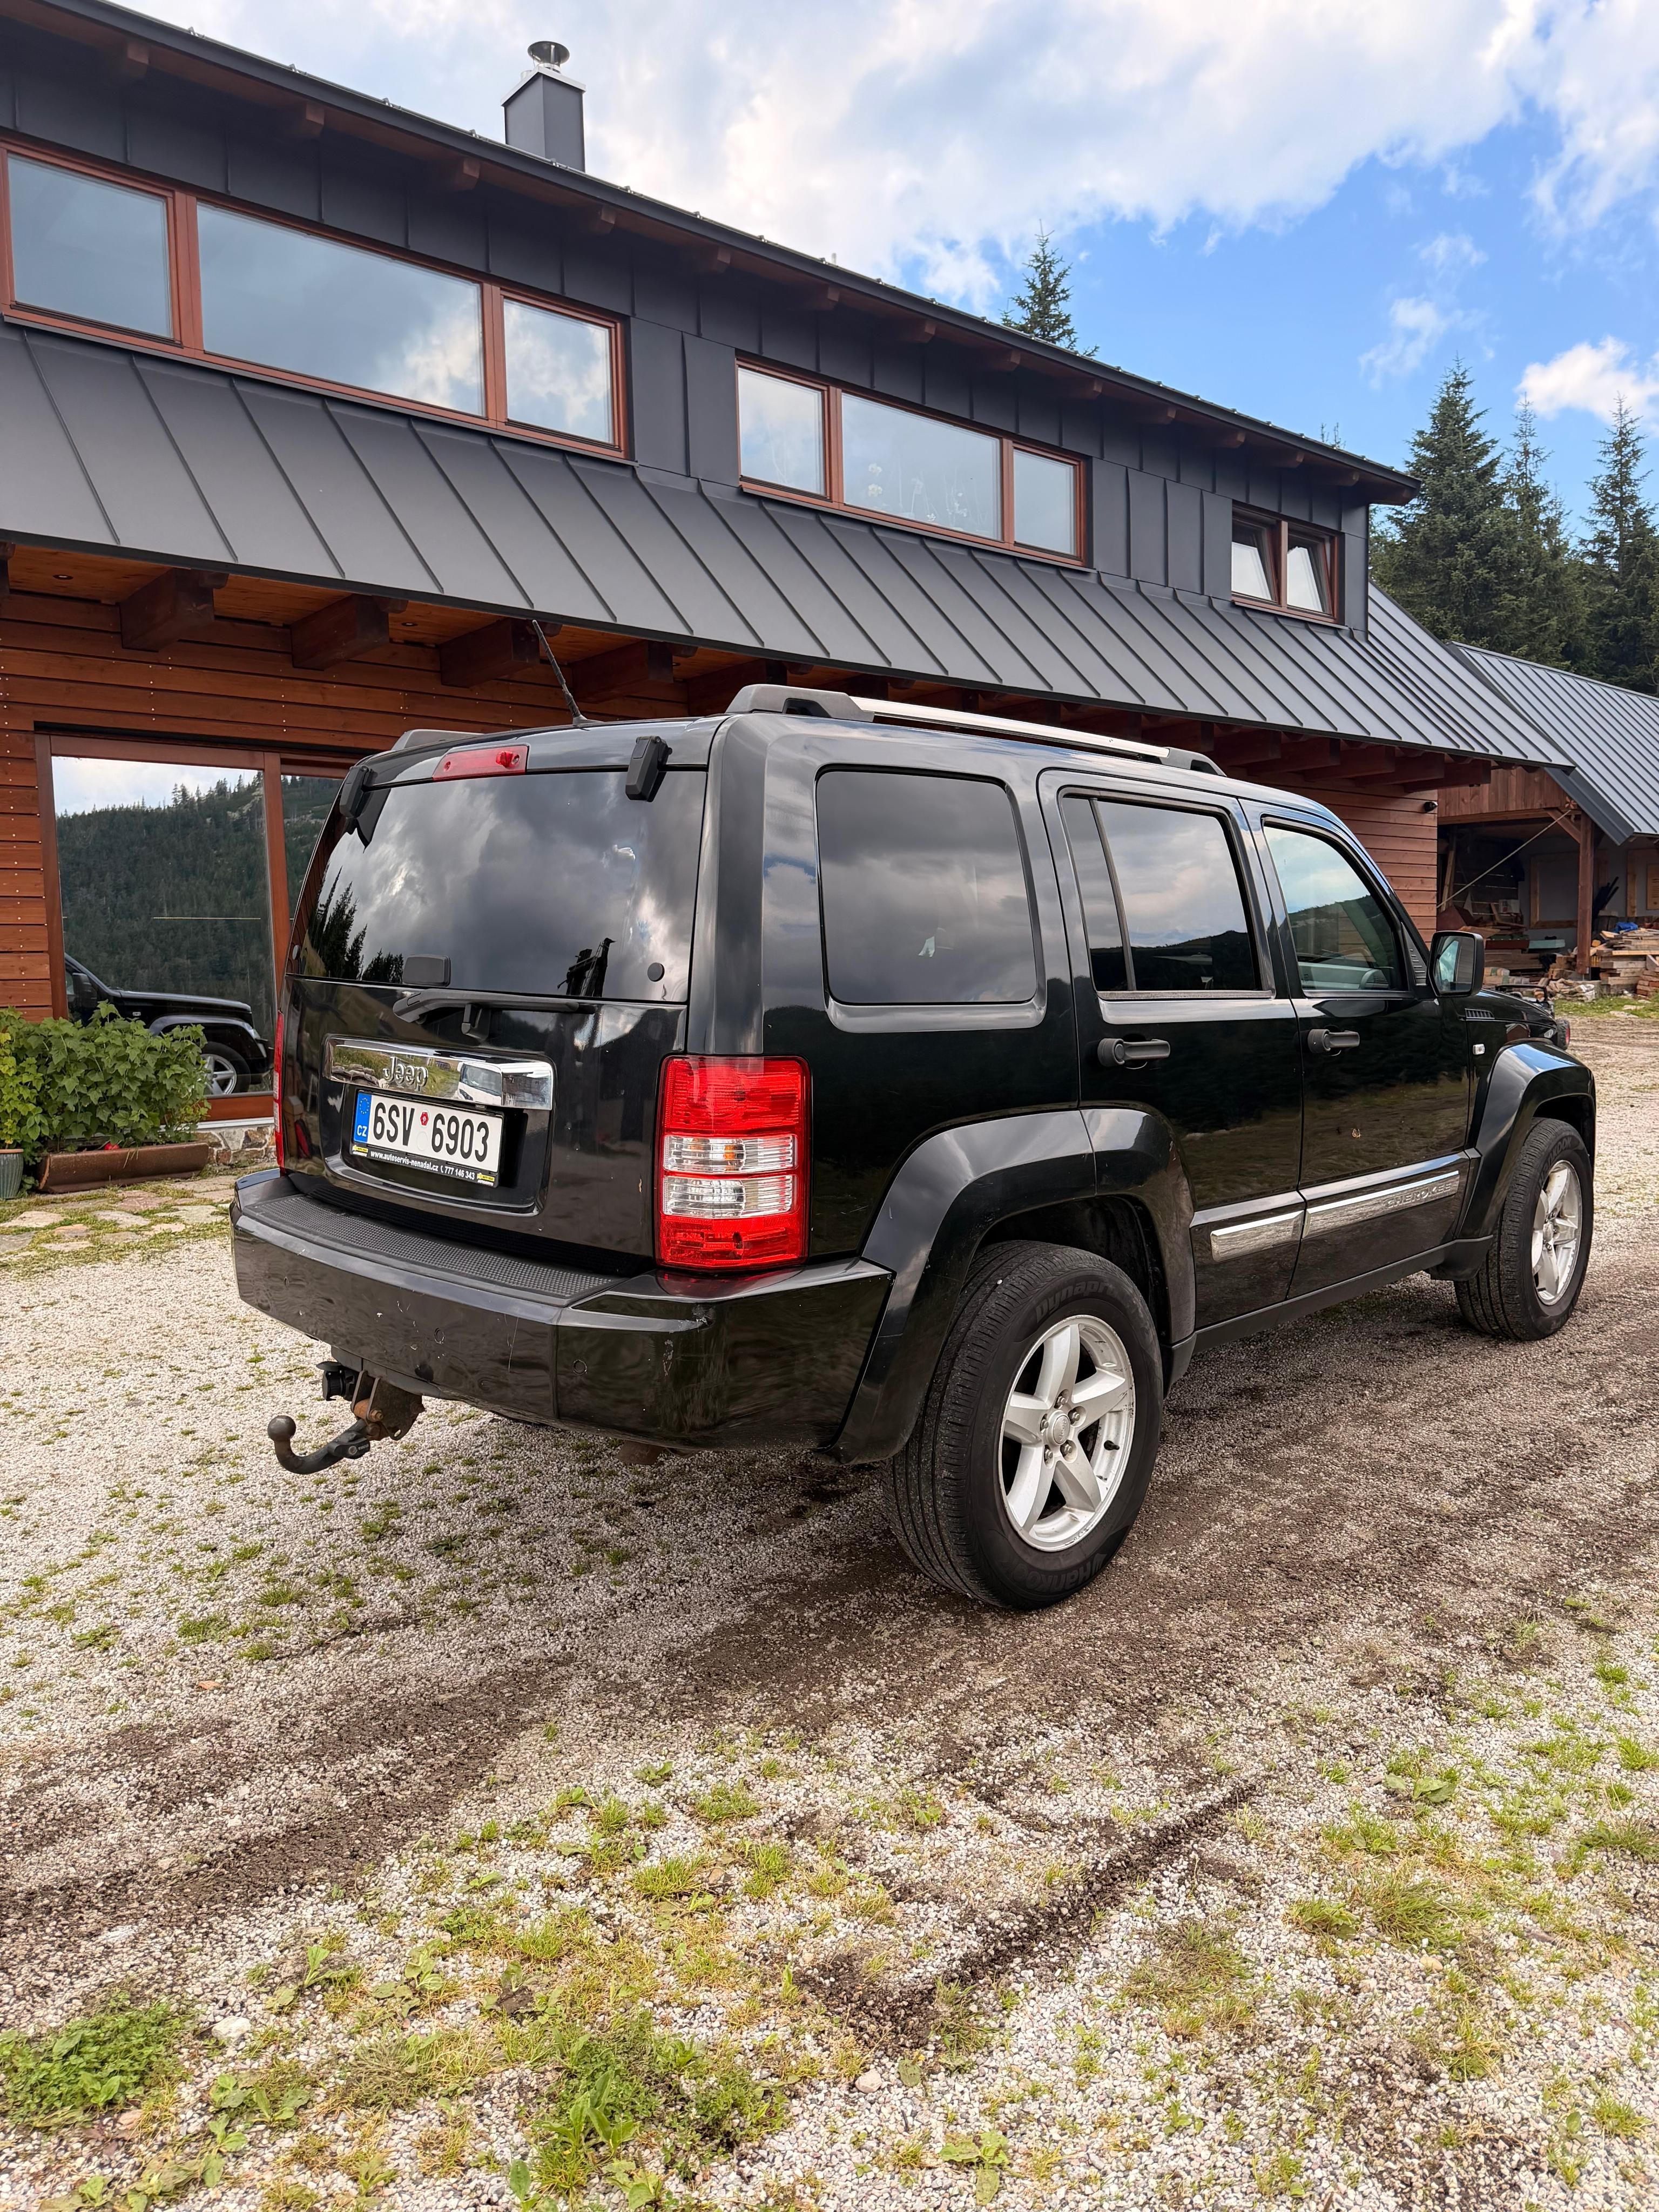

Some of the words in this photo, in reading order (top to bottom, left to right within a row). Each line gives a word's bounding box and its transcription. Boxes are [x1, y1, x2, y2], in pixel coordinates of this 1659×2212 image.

[383, 1056, 428, 1091] Jeep
[357, 1125, 367, 1137] CZ
[373, 1102, 415, 1146] 6SV
[432, 1114, 489, 1162] 6903
[370, 1151, 439, 1172] www.autoservis-nenadal.cz
[445, 1166, 454, 1175] 777
[455, 1169, 464, 1177] 146
[465, 1171, 475, 1180] 343
[1386, 1183, 1452, 1208] CHEROKEE
